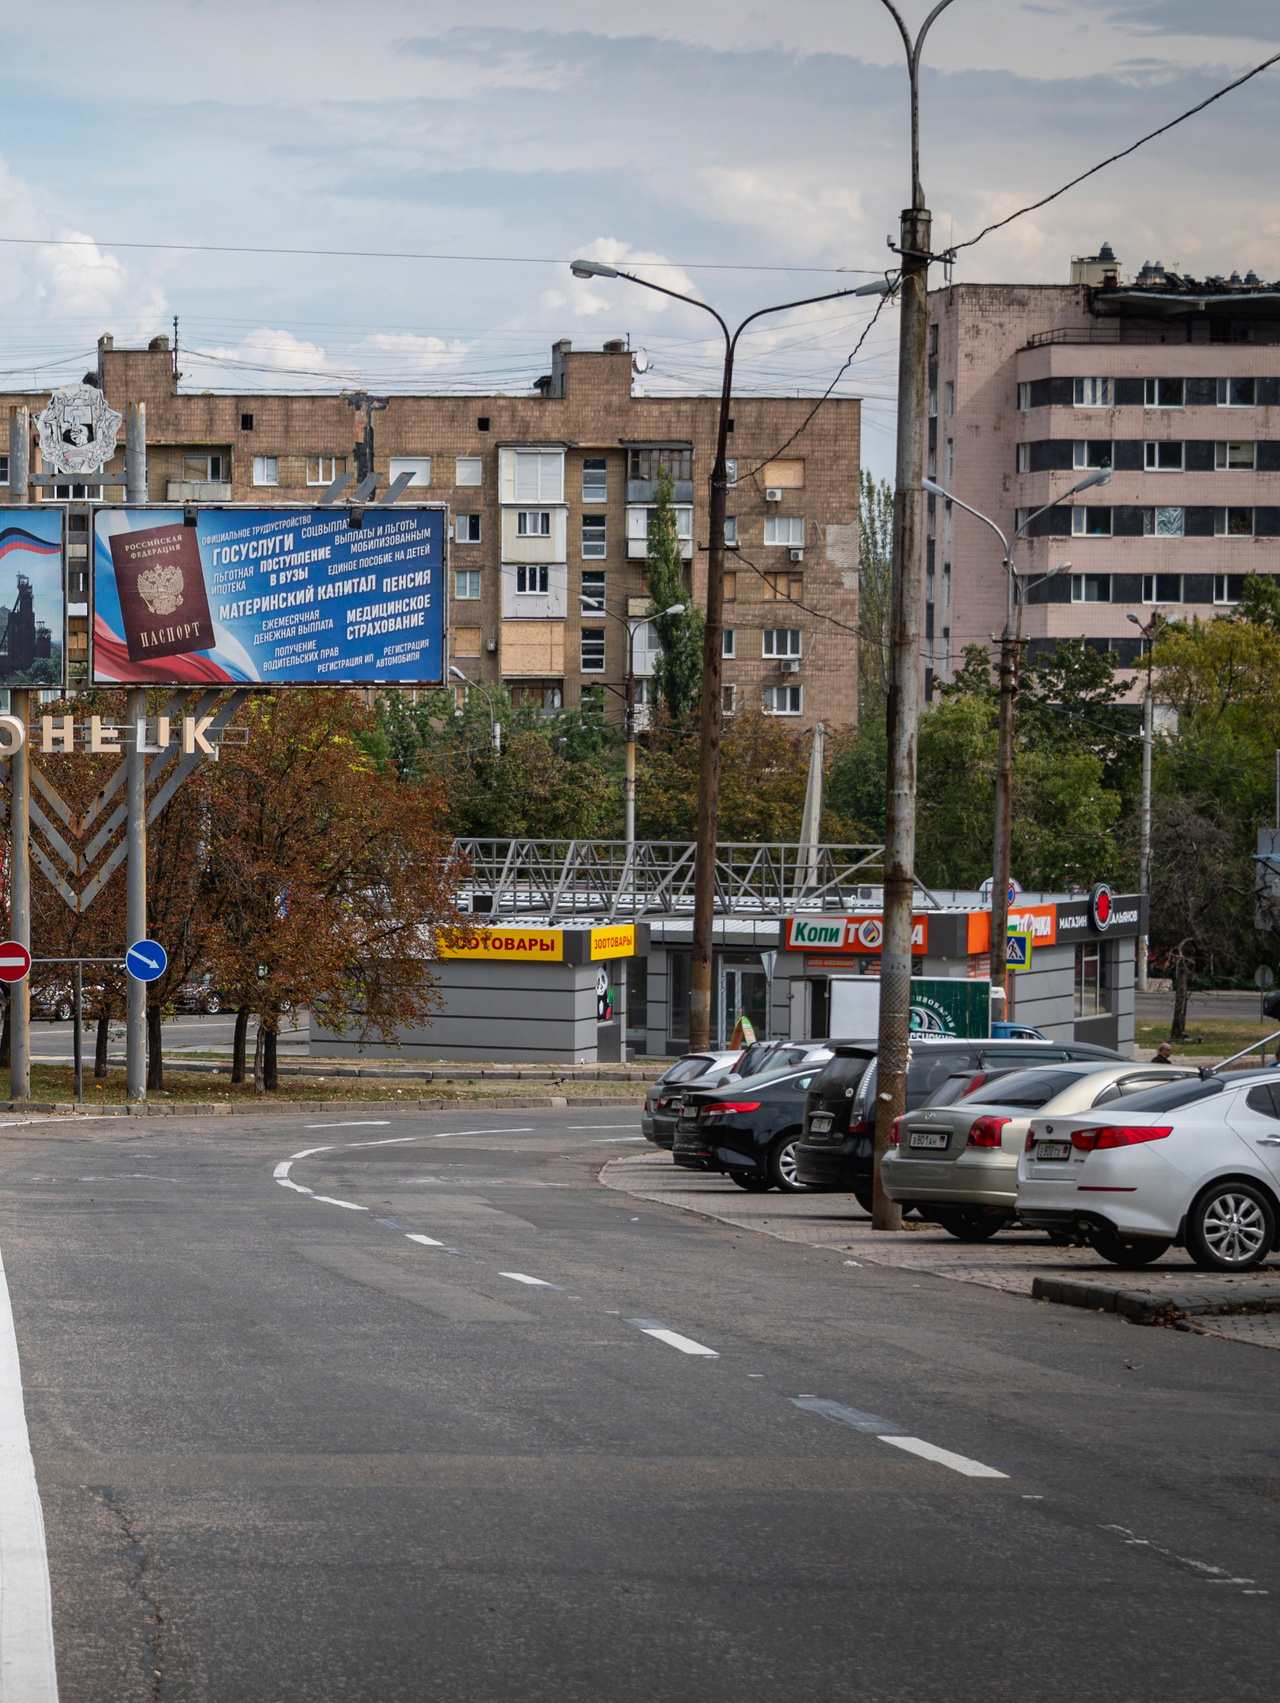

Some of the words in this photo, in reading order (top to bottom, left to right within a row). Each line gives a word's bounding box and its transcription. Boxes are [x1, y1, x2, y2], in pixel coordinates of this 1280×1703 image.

[201, 527, 251, 546] ОФИЦИАЛЬНОЕ
[301, 518, 350, 539] СОЦВЫПЛАТ
[334, 527, 375, 546] ВЫПЛАТЫ
[377, 525, 383, 536] И
[384, 518, 417, 535] ЛЬГОТЫ
[124, 534, 183, 552] РОССИЙСКАЯ
[130, 544, 181, 559] ФЕДЕРАЦИЯ
[212, 533, 294, 566] ГОСУСЛУГИ
[350, 527, 431, 554] МОБИЛИЗОВАННЫМ
[259, 546, 332, 573] ПОСТУПЛЕНИЕ
[328, 560, 358, 576] ЕДИНОЕ
[359, 552, 393, 569] ПОСОБИЕ
[394, 550, 405, 562] НА
[406, 543, 431, 560] ДЕТЕЙ
[213, 566, 254, 584] ЛЬГОТНАЯ
[269, 573, 277, 587] В
[279, 566, 309, 585] ВУЗЫ
[382, 569, 431, 593] ПЕНСИЯ
[211, 580, 246, 595] ИПОТЕКА
[219, 584, 314, 621] МАТЕРИНСКИЙ
[317, 574, 376, 601] КАПИТАЛ
[262, 609, 320, 631] ЕЖЕМЕСЯЧНАЯ
[346, 594, 431, 624] МЕДИЦИНСКОЕ
[140, 621, 200, 648] ПАСПОРТ
[253, 627, 296, 646] ДЕНЕЖНАЯ
[298, 618, 334, 636] ВЫПЛАТА
[346, 611, 425, 641] СТРАХОВАНИЕ
[275, 639, 317, 658] ПОЛУЧЕНИЕ
[383, 638, 430, 656] РЕГИСТРАЦИЯ
[263, 651, 319, 672] ВОДИТЕЛЬСКИХ
[320, 646, 339, 659] ПРАВ
[317, 655, 363, 674] РЕГИСТРАЦИЯ
[364, 653, 374, 664] ИП
[375, 651, 420, 668] АВТОМОБИЛЯ
[1059, 915, 1087, 930] МАГАЗИН
[1110, 910, 1138, 925] АЛЬЯНОВ
[594, 935, 632, 950] ЗООТОВАРЫ
[794, 922, 840, 943] Копи
[847, 919, 924, 948] ТОА
